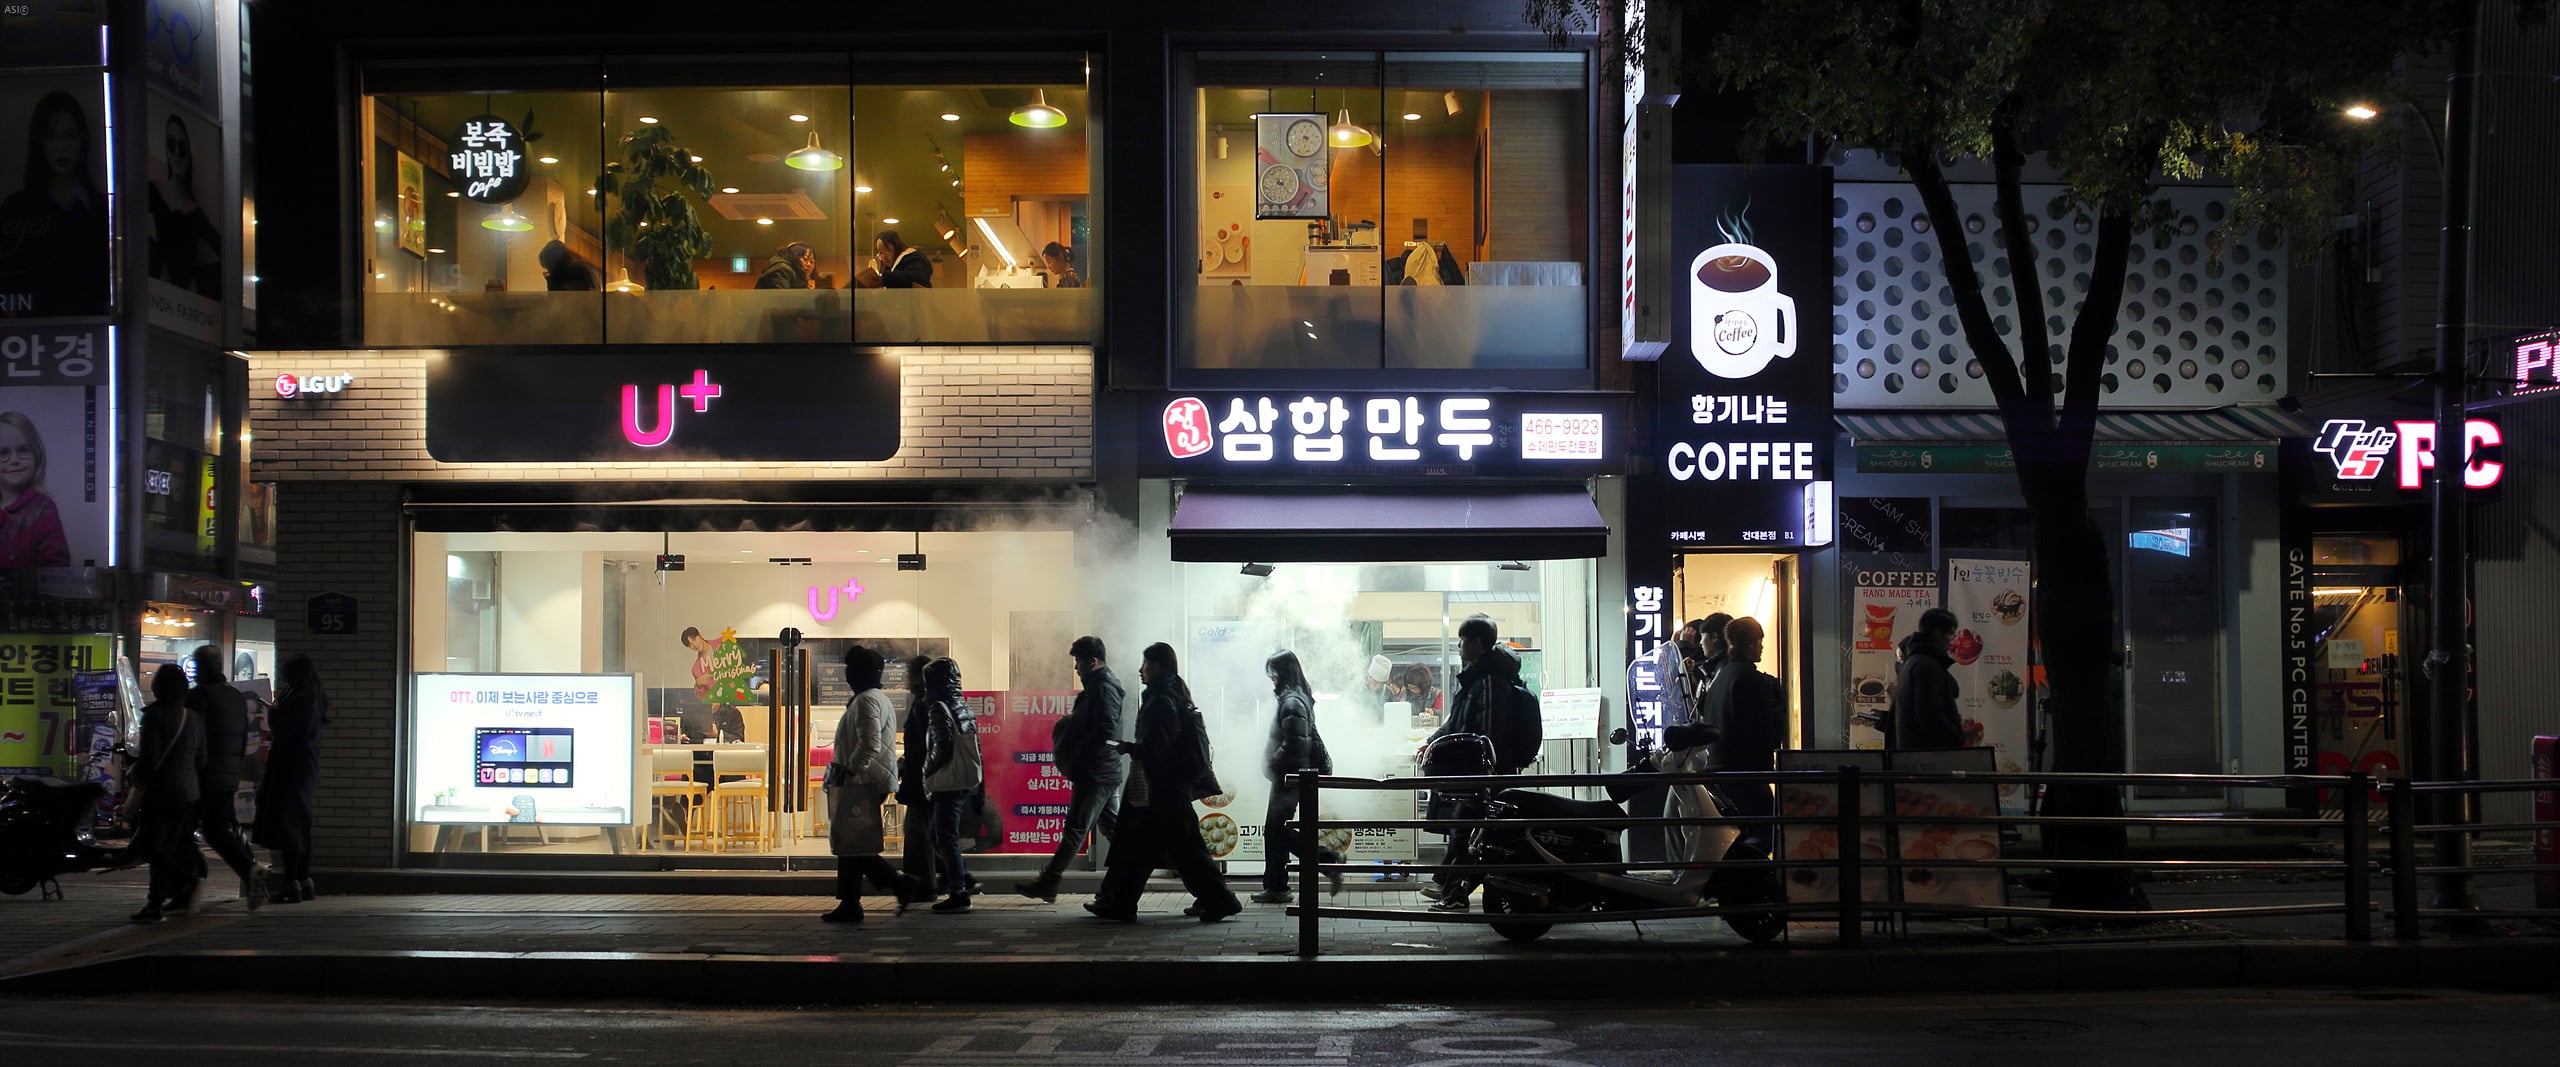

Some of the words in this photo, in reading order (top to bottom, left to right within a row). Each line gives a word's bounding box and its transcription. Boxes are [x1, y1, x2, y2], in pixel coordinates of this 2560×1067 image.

[461, 121, 512, 150] 본죽
[451, 149, 522, 178] 비빔밥
[1718, 327, 1753, 342] Coffee
[1, 333, 94, 379] 안경
[621, 369, 722, 448] U+
[1691, 394, 1788, 424] 향기나는
[1218, 395, 1494, 462] 삼합만두
[1525, 419, 1599, 435] 466-9923
[1527, 440, 1597, 453] 수제만두전문점
[1668, 441, 1814, 481] COFFEE
[2098, 460, 2143, 468] SHUCREAM
[1742, 530, 1776, 541] 건대본점
[1784, 531, 1794, 541] B1
[1857, 571, 1937, 587] COFFEE
[1971, 564, 2024, 585] 눈꽃빙수
[2289, 548, 2304, 600] GATE
[808, 578, 865, 621] U+
[1862, 588, 1886, 599] HAND
[1888, 588, 1912, 599] MADE
[1914, 588, 1930, 599] TEA
[321, 614, 345, 631] 95
[1198, 626, 1228, 637] Cold
[2290, 607, 2306, 649] No.5
[1633, 586, 1664, 691] 향기나는
[0, 644, 92, 673] 안경테
[700, 649, 743, 673] Merry
[713, 663, 758, 681] Christmas
[2291, 656, 2307, 683] PC
[476, 691, 499, 704] 이제
[502, 691, 549, 704] 보는사람
[551, 691, 598, 704] 중심으로
[2292, 688, 2308, 769] CENTER
[1021, 753, 1036, 762] 지금
[1038, 753, 1056, 762] 체험
[1027, 778, 1061, 791] 실시간
[1021, 805, 1036, 815] 즉시
[1036, 818, 1060, 830] AI가
[1239, 825, 1265, 837] 고기
[1009, 832, 1051, 844] 전화받는
